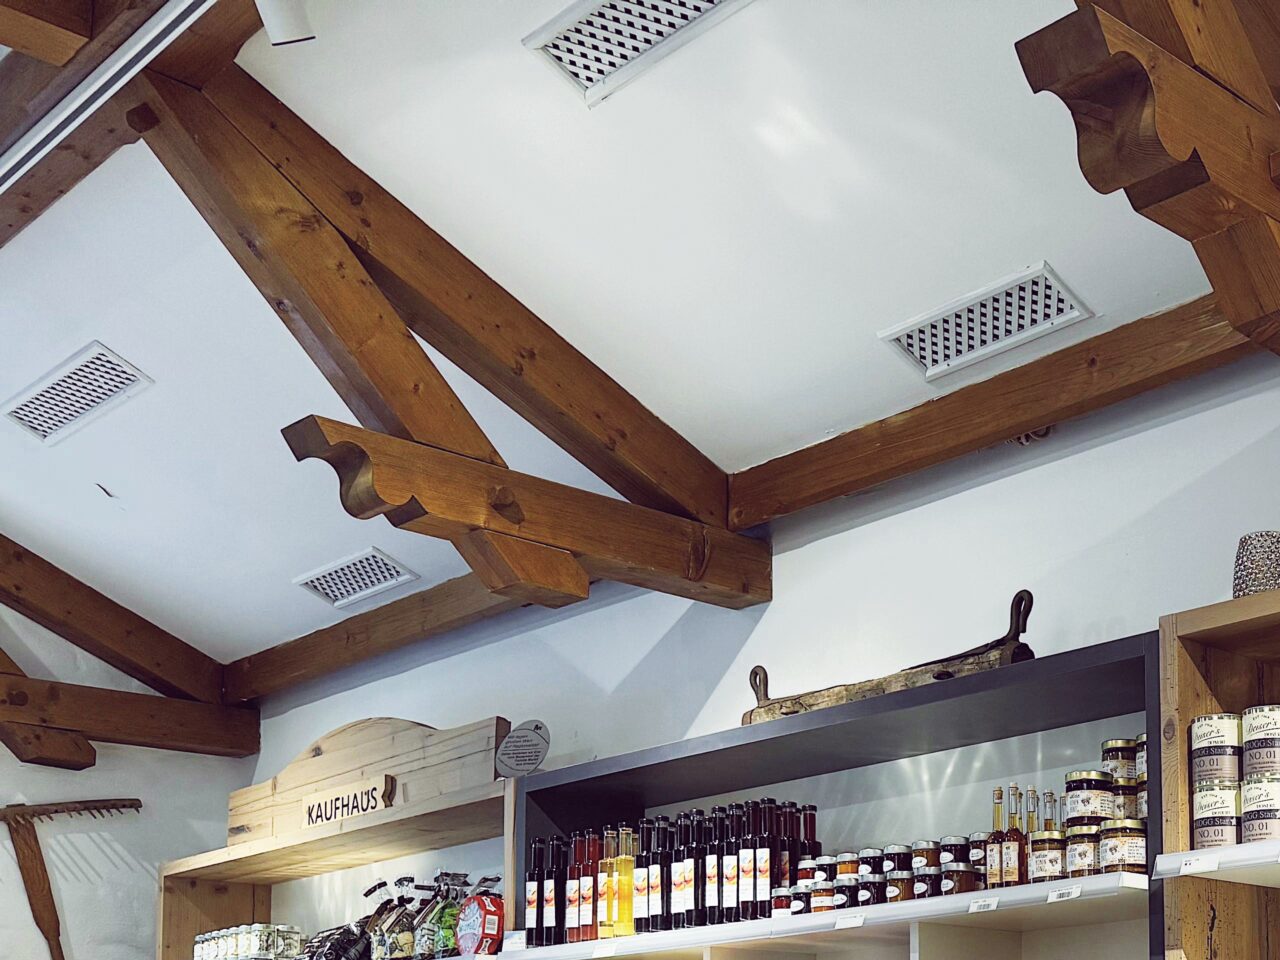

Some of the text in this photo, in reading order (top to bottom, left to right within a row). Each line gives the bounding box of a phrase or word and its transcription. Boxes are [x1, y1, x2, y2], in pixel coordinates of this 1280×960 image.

[1266, 750, 1277, 759] 01
[1209, 758, 1219, 767] 01
[308, 787, 378, 826] KAUFHAUS
[1258, 822, 1269, 830] 01
[1214, 829, 1224, 837] 01
